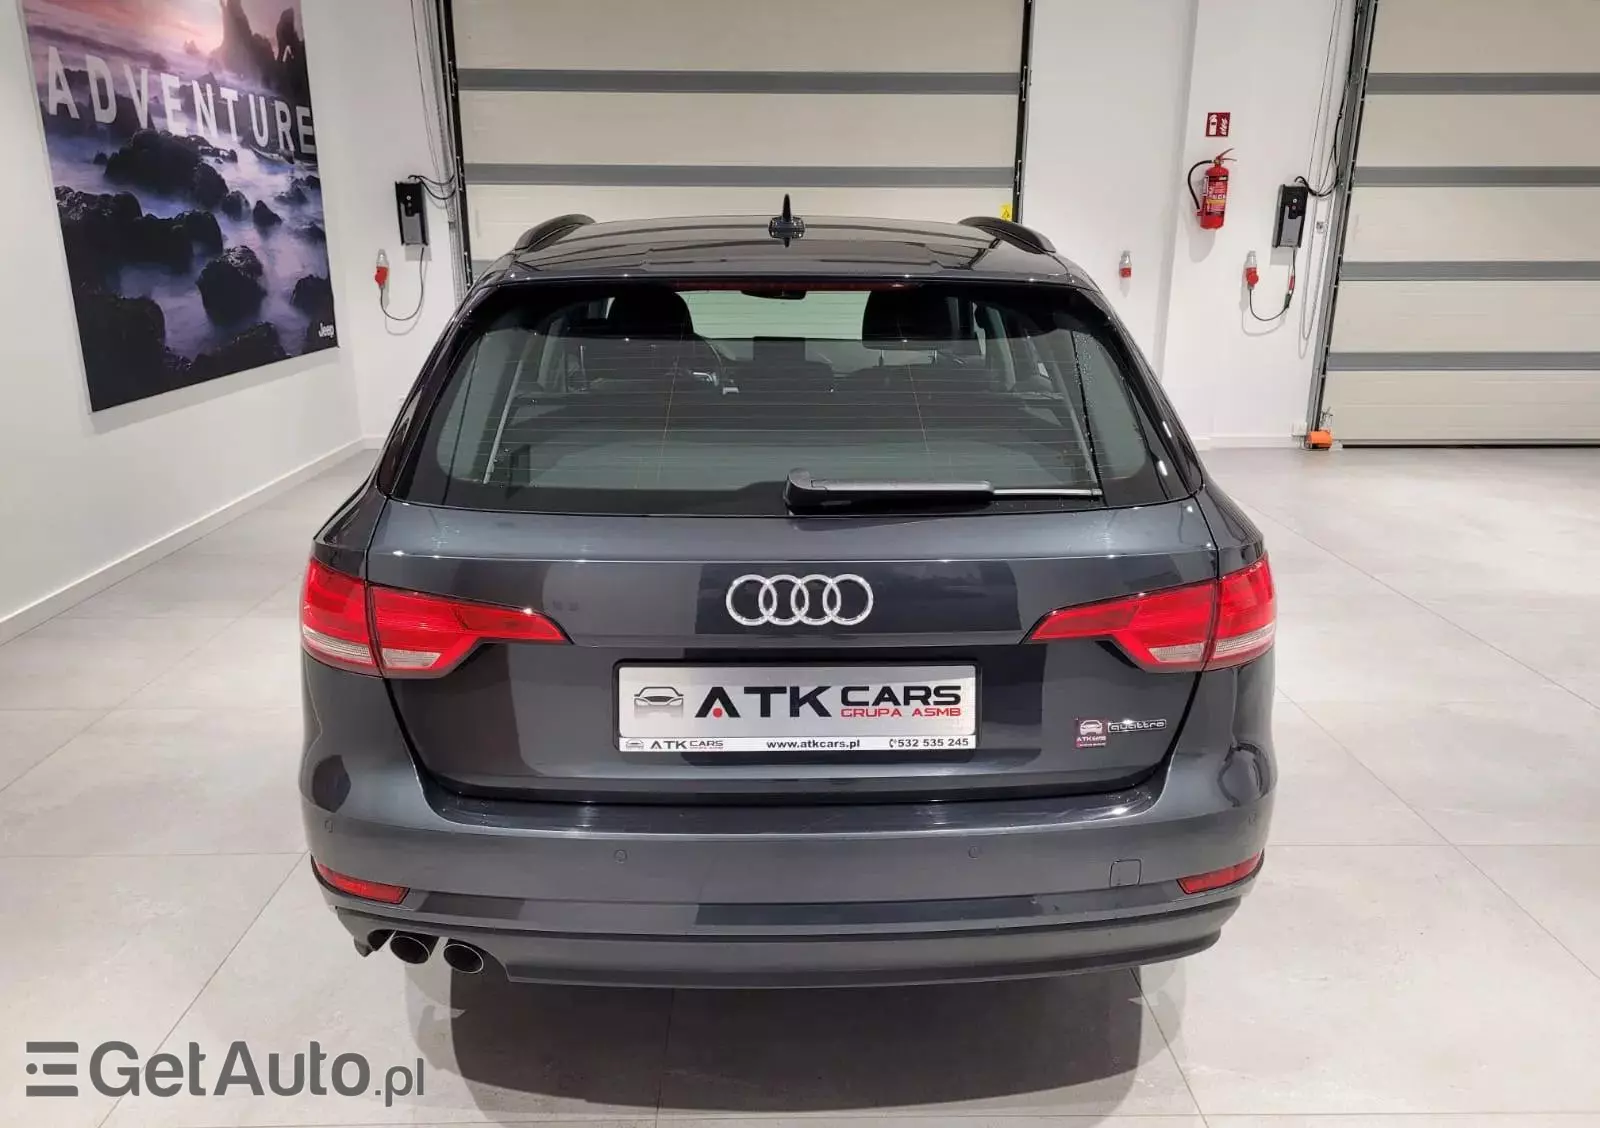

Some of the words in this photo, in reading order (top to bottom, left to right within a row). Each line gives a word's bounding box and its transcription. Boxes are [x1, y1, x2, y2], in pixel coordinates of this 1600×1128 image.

[48, 46, 316, 154] ADVENTURE
[318, 322, 334, 338] Jeep
[694, 686, 832, 718] ATK
[840, 685, 962, 707] CARS
[840, 708, 902, 718] GRUPA
[911, 707, 962, 718] ASMB
[1110, 720, 1165, 731] quattro
[650, 740, 688, 750] ATK
[766, 739, 861, 749] www.atkcars.pl
[898, 738, 919, 748] 532
[923, 738, 944, 748] 535
[948, 737, 969, 747] 245
